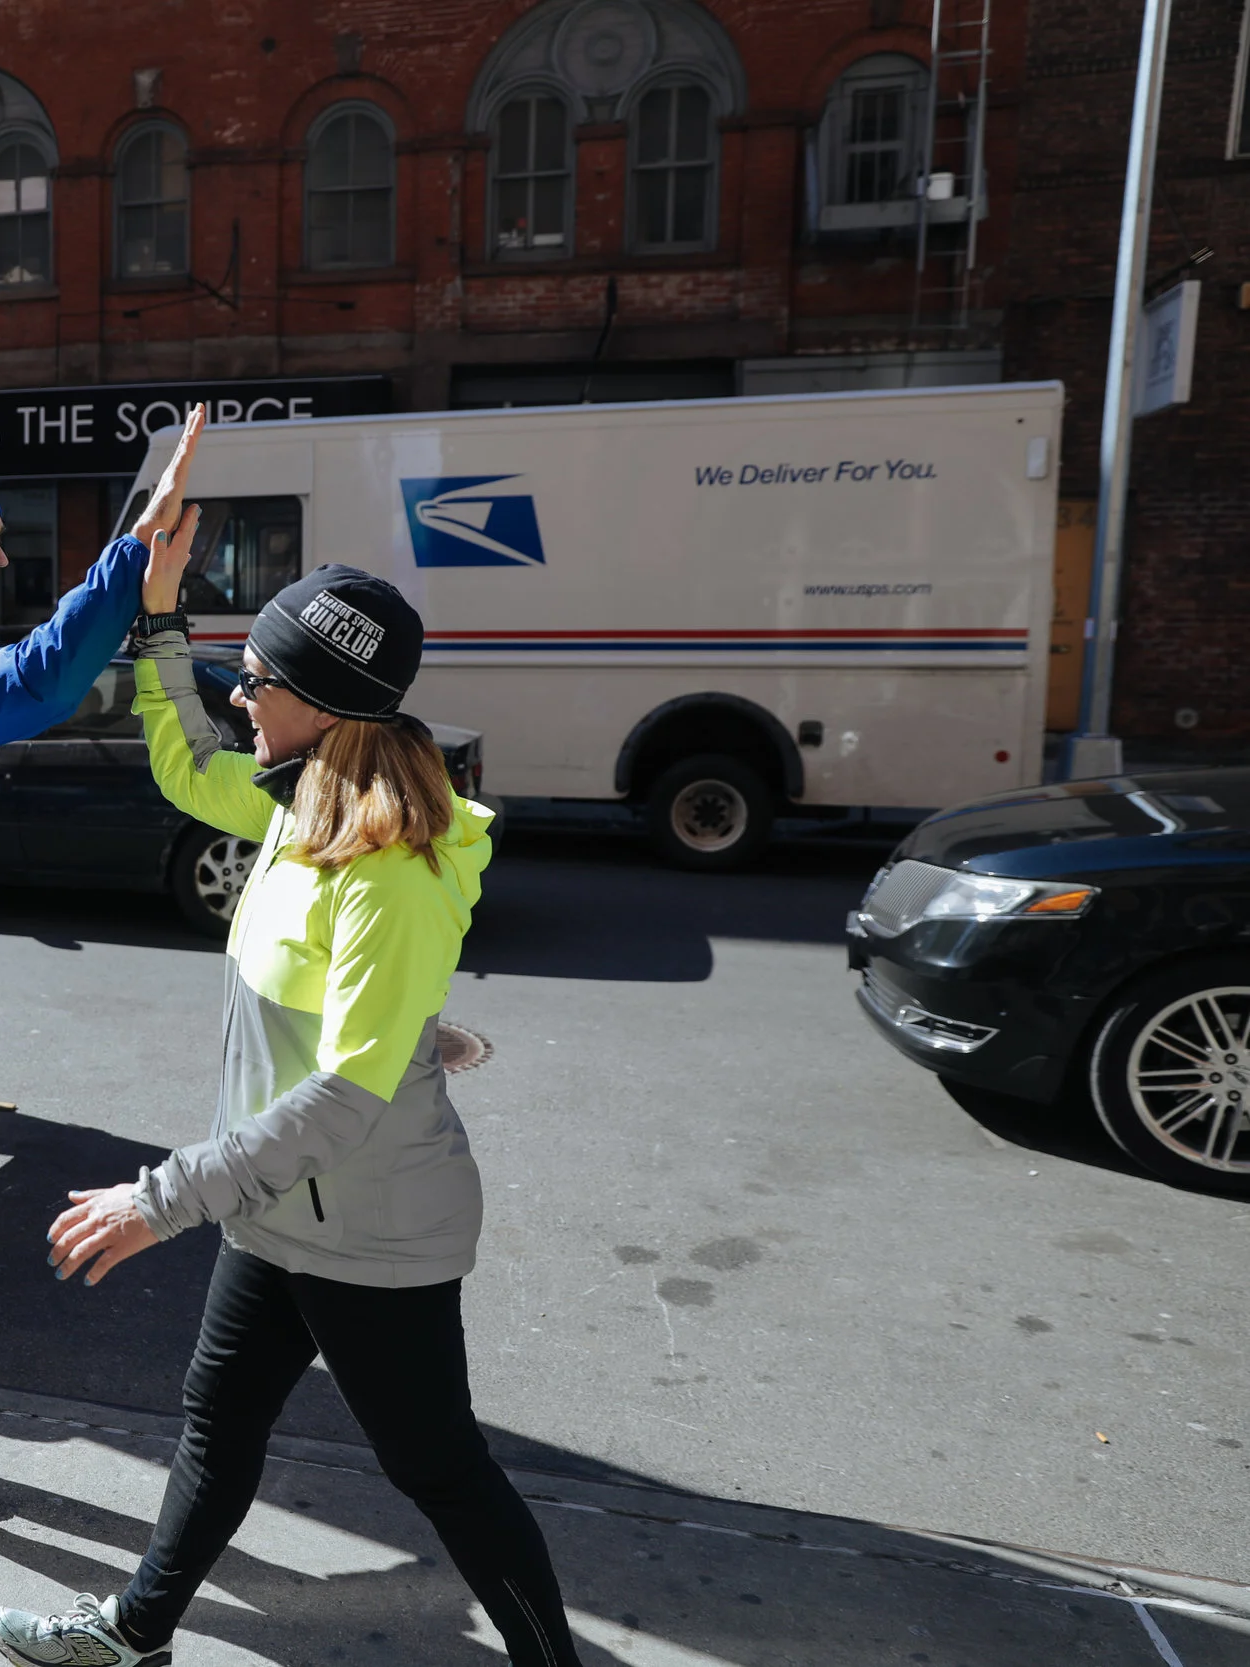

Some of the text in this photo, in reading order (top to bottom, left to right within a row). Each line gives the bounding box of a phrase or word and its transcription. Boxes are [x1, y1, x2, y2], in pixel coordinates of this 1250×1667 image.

[18, 405, 94, 444] THE
[695, 459, 937, 486] We Deliver For You.
[804, 583, 933, 598] www.usps.com
[300, 600, 379, 660] RUN CLUB
[315, 592, 384, 642] PARAGON SPORTS
